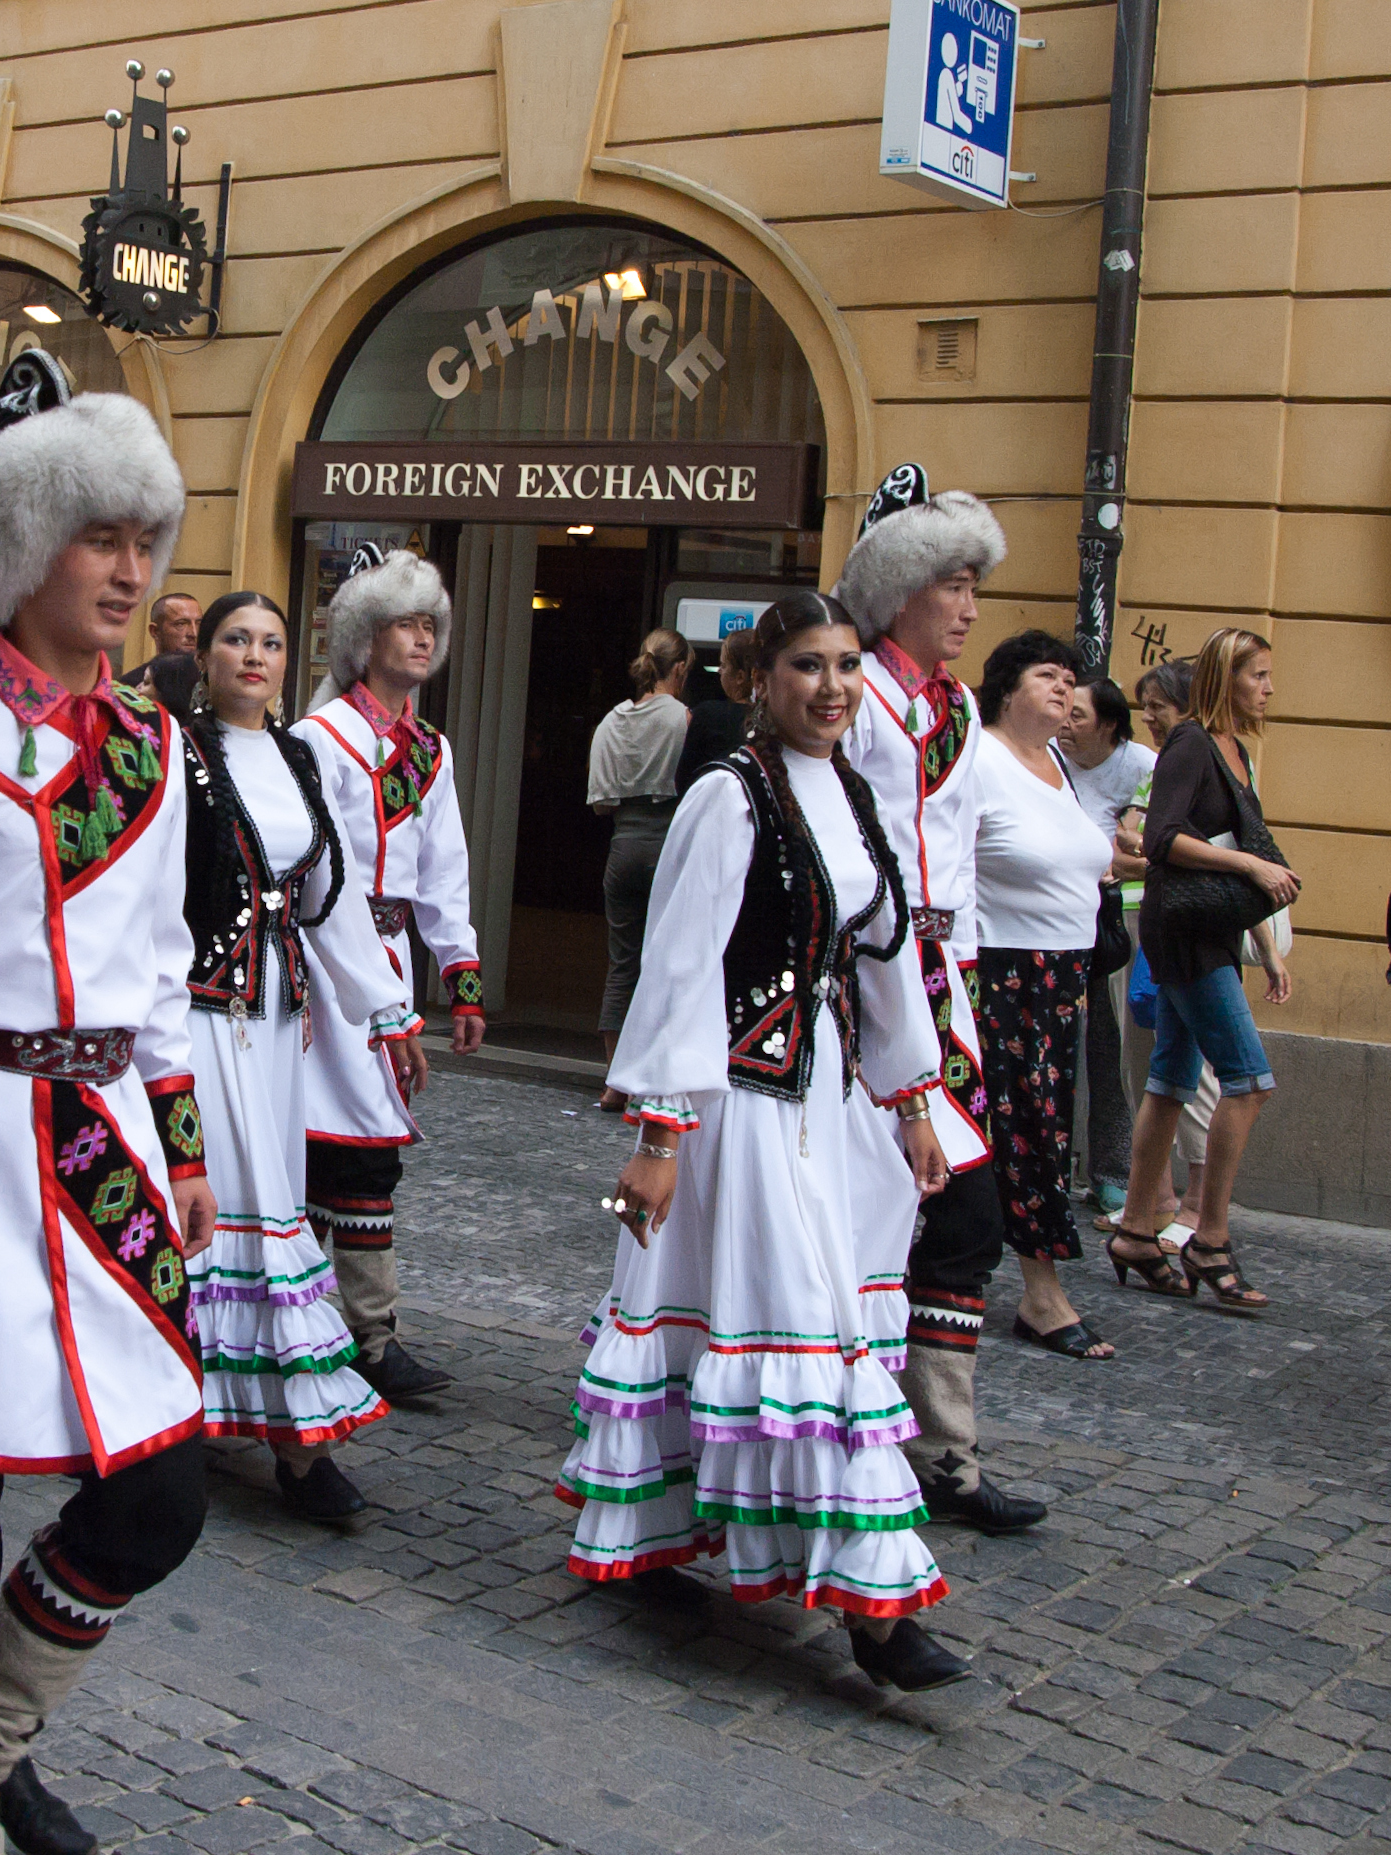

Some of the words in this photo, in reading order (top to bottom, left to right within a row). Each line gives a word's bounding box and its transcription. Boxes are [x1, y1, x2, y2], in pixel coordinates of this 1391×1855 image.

[934, 0, 1012, 41] NKOMAT
[952, 146, 974, 179] citi
[112, 242, 189, 294] CHANGE
[427, 285, 726, 401] CHANGE
[323, 463, 505, 497] FOREIGN
[515, 464, 756, 501] EXCHANGE
[725, 616, 747, 632] citi
